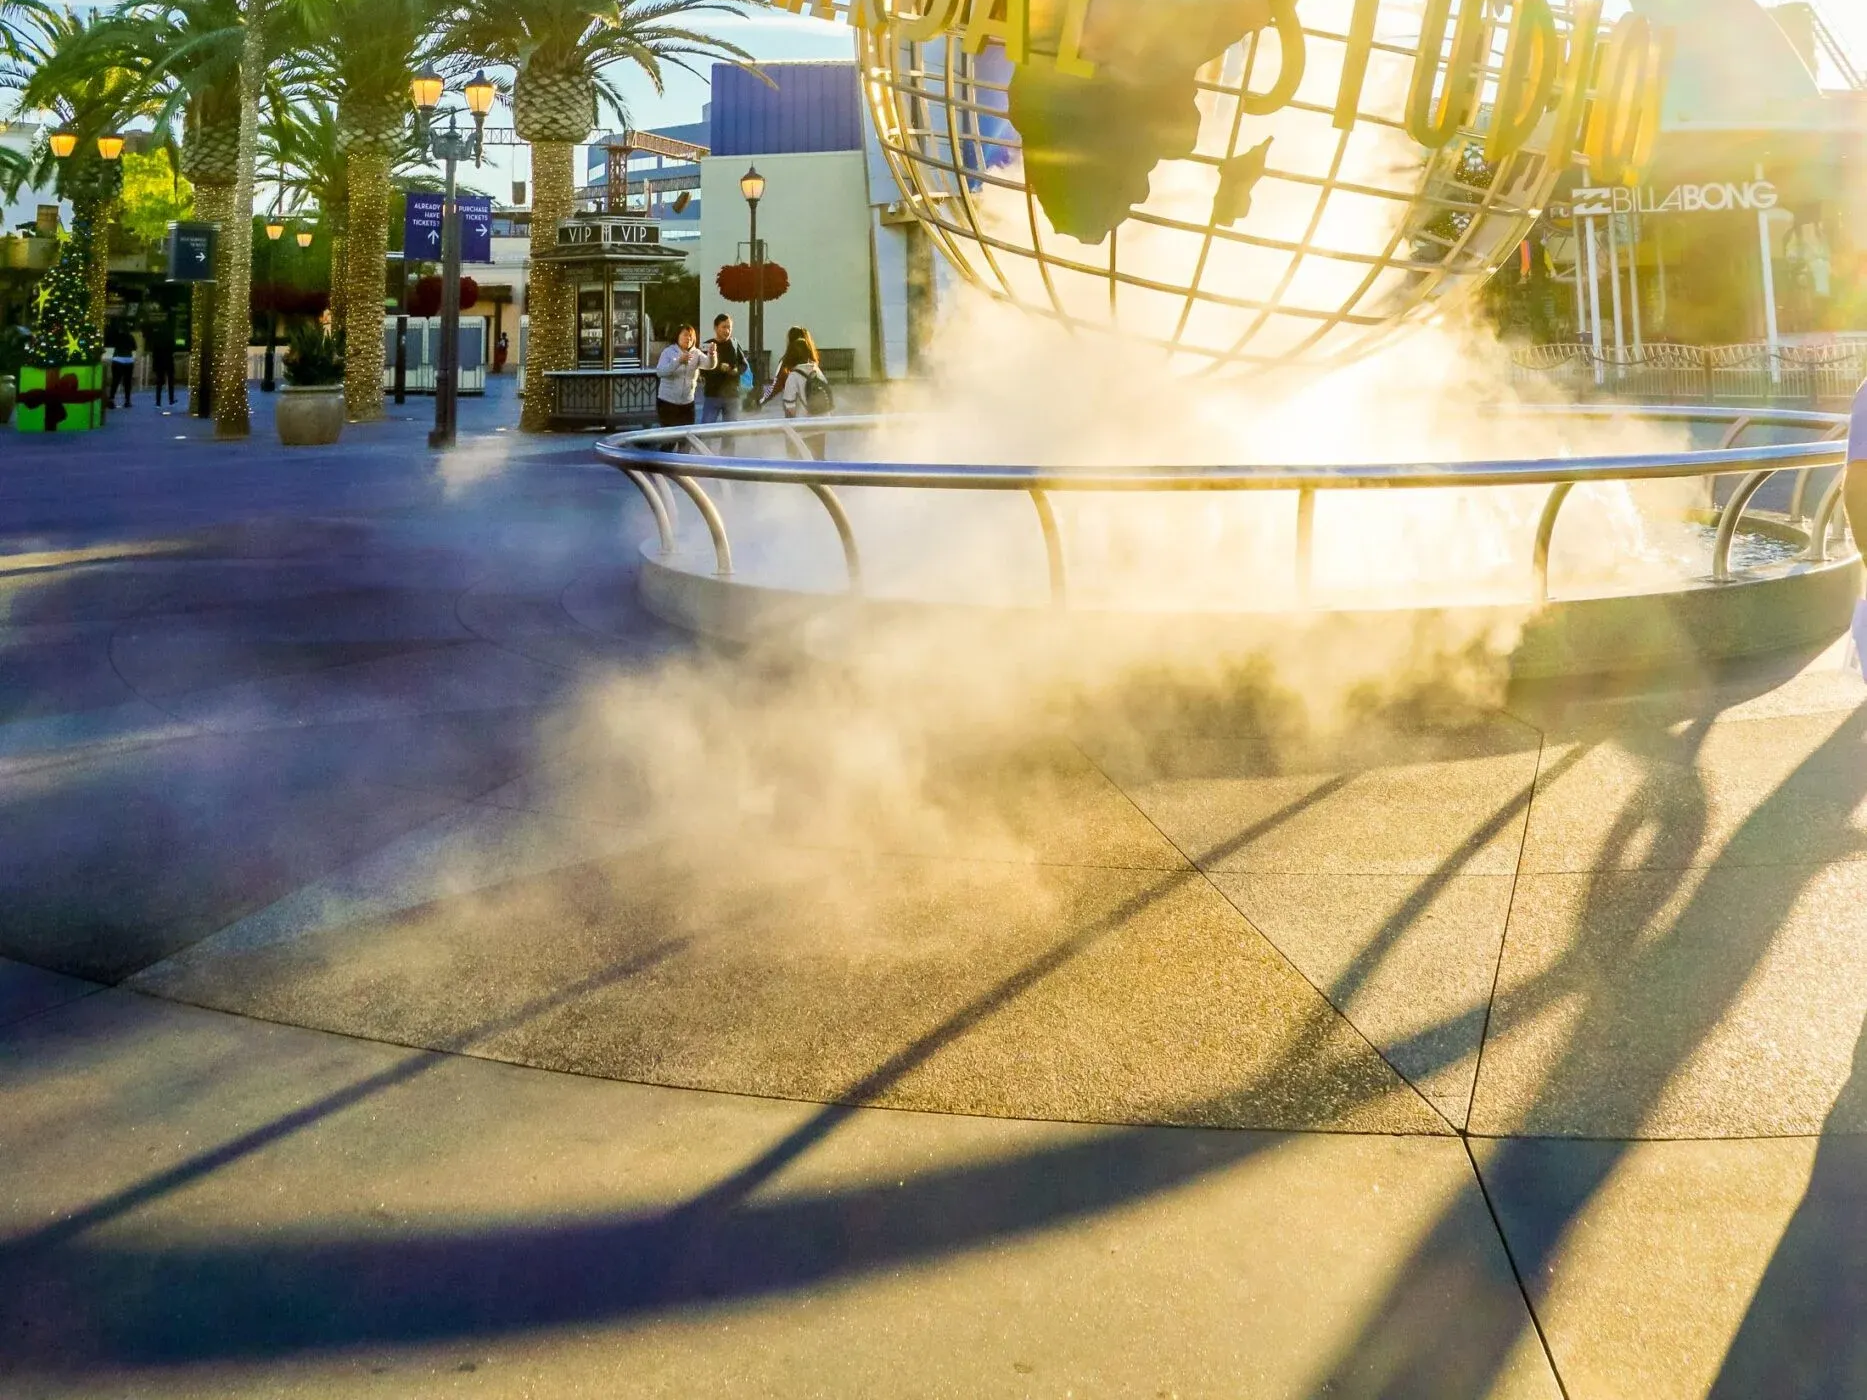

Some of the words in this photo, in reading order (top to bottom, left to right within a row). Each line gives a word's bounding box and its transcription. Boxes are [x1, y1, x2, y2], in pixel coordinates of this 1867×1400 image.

[1612, 180, 1778, 214] BILLABONG
[413, 202, 441, 210] ALREADY
[458, 205, 489, 213] PURCHASE
[424, 211, 440, 219] HAVE
[465, 213, 488, 221] TICKETS
[413, 219, 440, 227] TICKETS?
[568, 226, 592, 243] VIP
[621, 225, 647, 242] VIP
